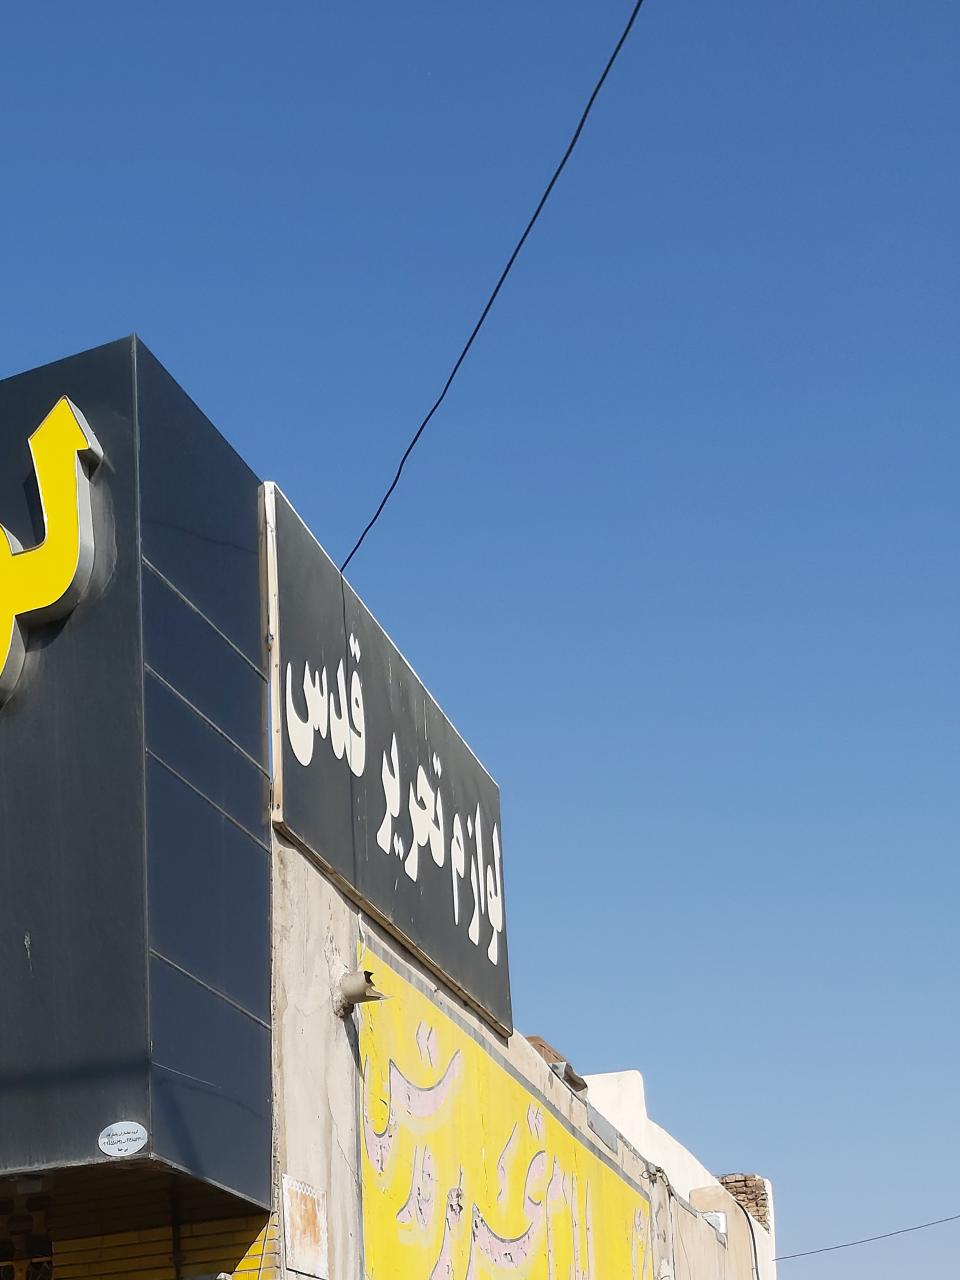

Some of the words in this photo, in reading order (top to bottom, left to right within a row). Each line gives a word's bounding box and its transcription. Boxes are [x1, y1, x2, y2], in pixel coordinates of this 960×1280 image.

[286, 633, 367, 778] قدس
[376, 732, 445, 882] تحریر
[451, 802, 503, 966] لوازم
